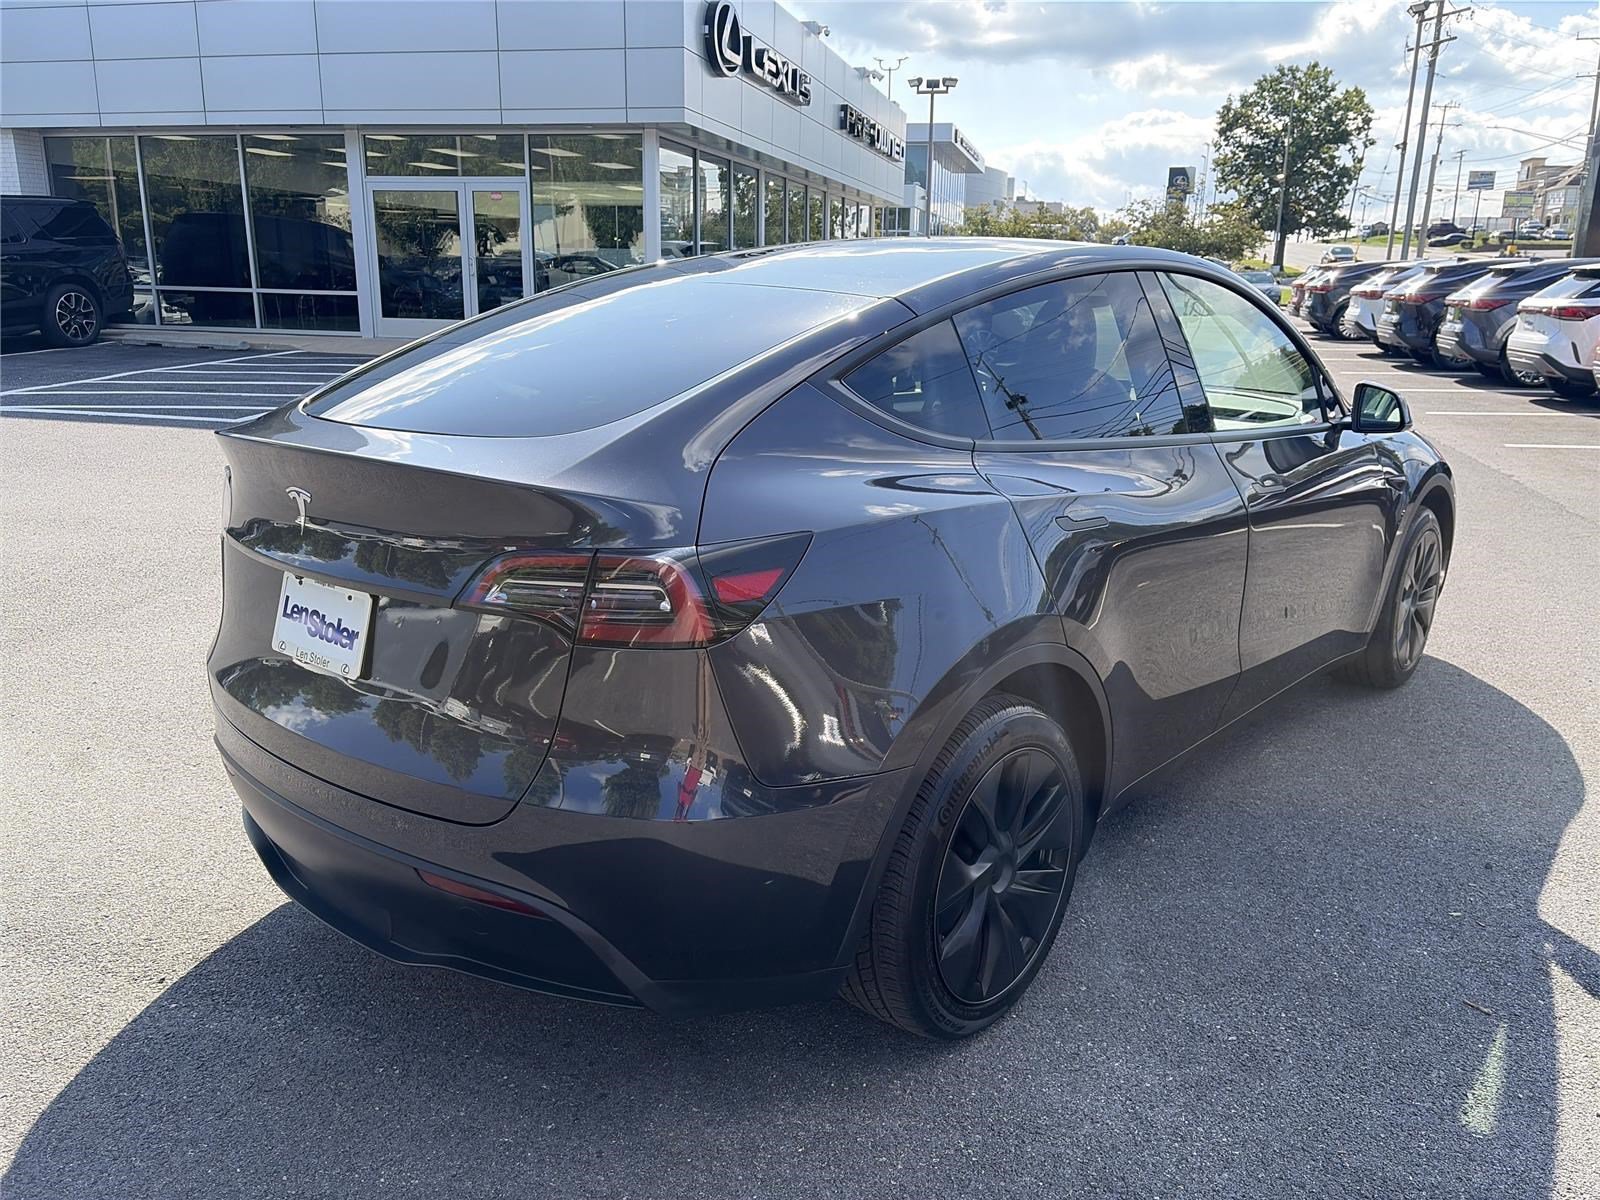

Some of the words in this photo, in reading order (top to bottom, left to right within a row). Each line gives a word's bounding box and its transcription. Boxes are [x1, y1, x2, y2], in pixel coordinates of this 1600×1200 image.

[743, 36, 812, 105] LEXUS
[296, 647, 309, 660] Len
[309, 651, 330, 667] Stoler
